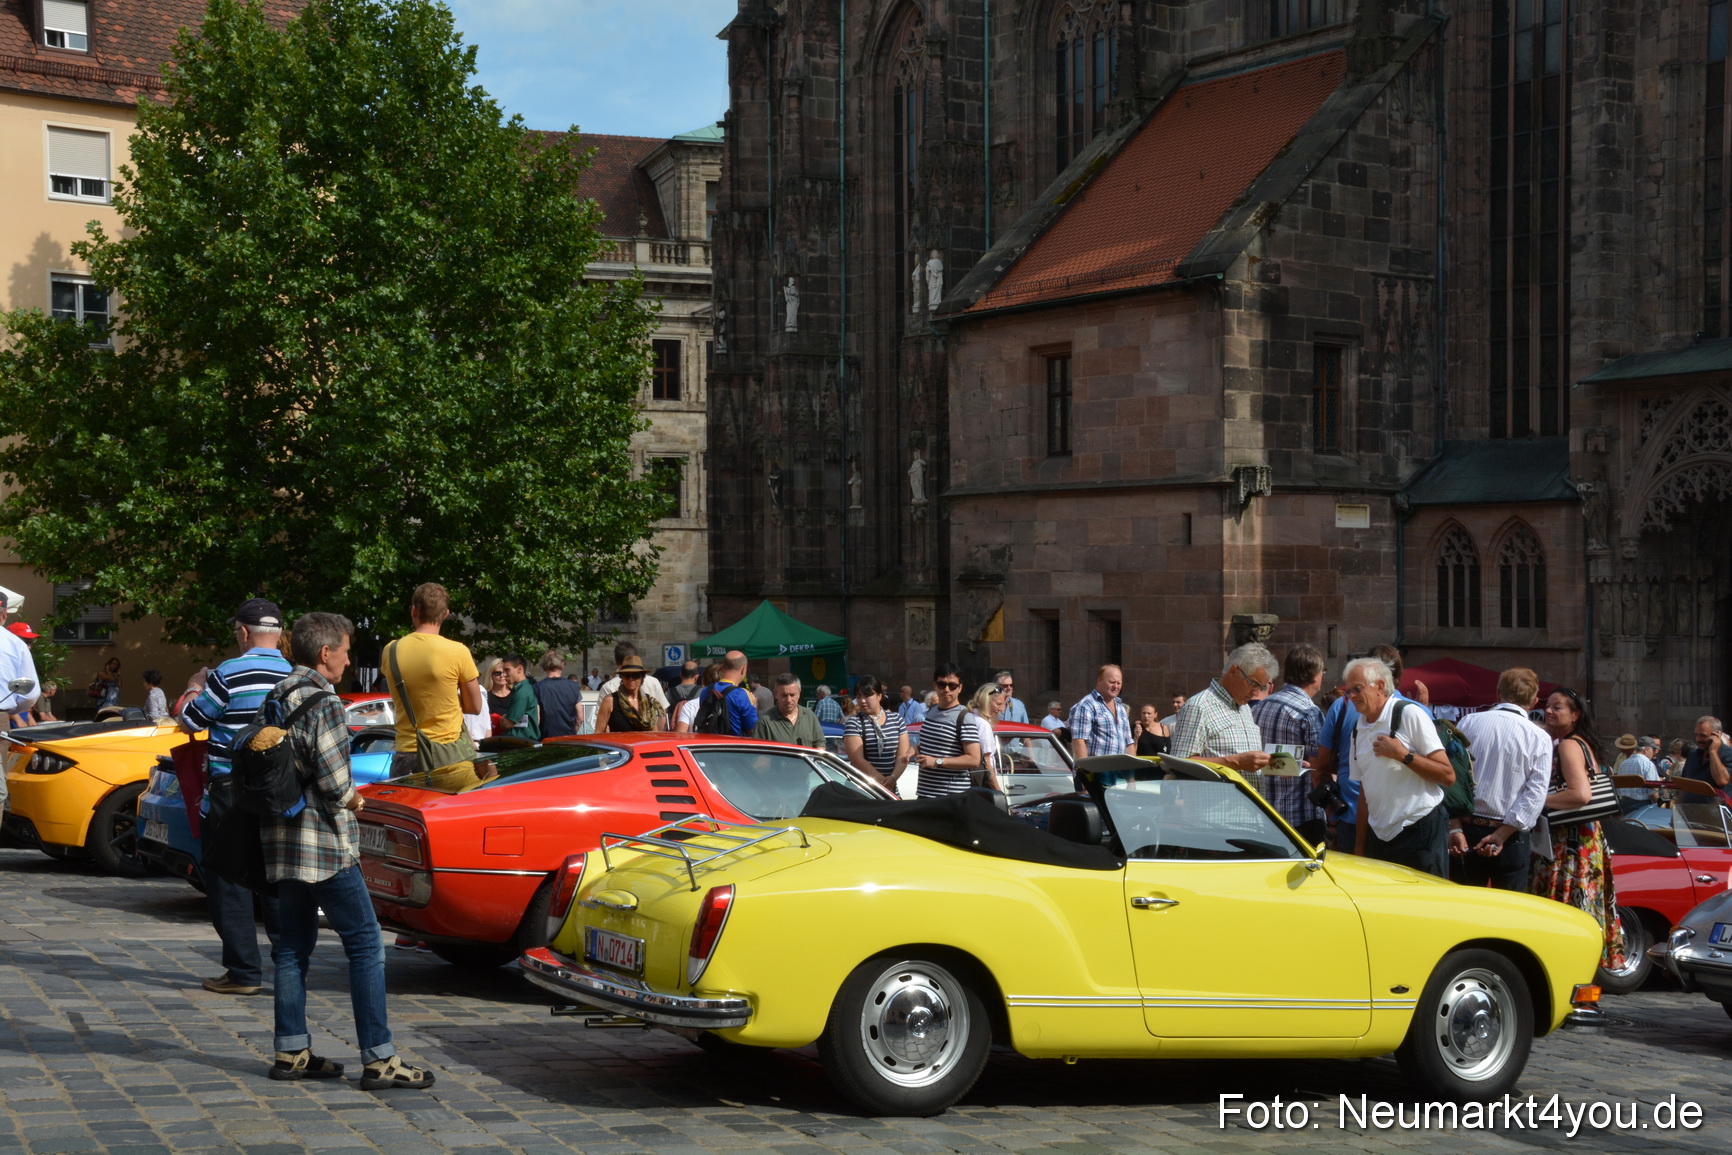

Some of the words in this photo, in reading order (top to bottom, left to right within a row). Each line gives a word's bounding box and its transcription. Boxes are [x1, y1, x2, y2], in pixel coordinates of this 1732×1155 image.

[712, 646, 727, 656] DEKRA
[790, 643, 815, 653] DEKRA
[598, 935, 605, 959] N
[609, 938, 633, 967] 0714
